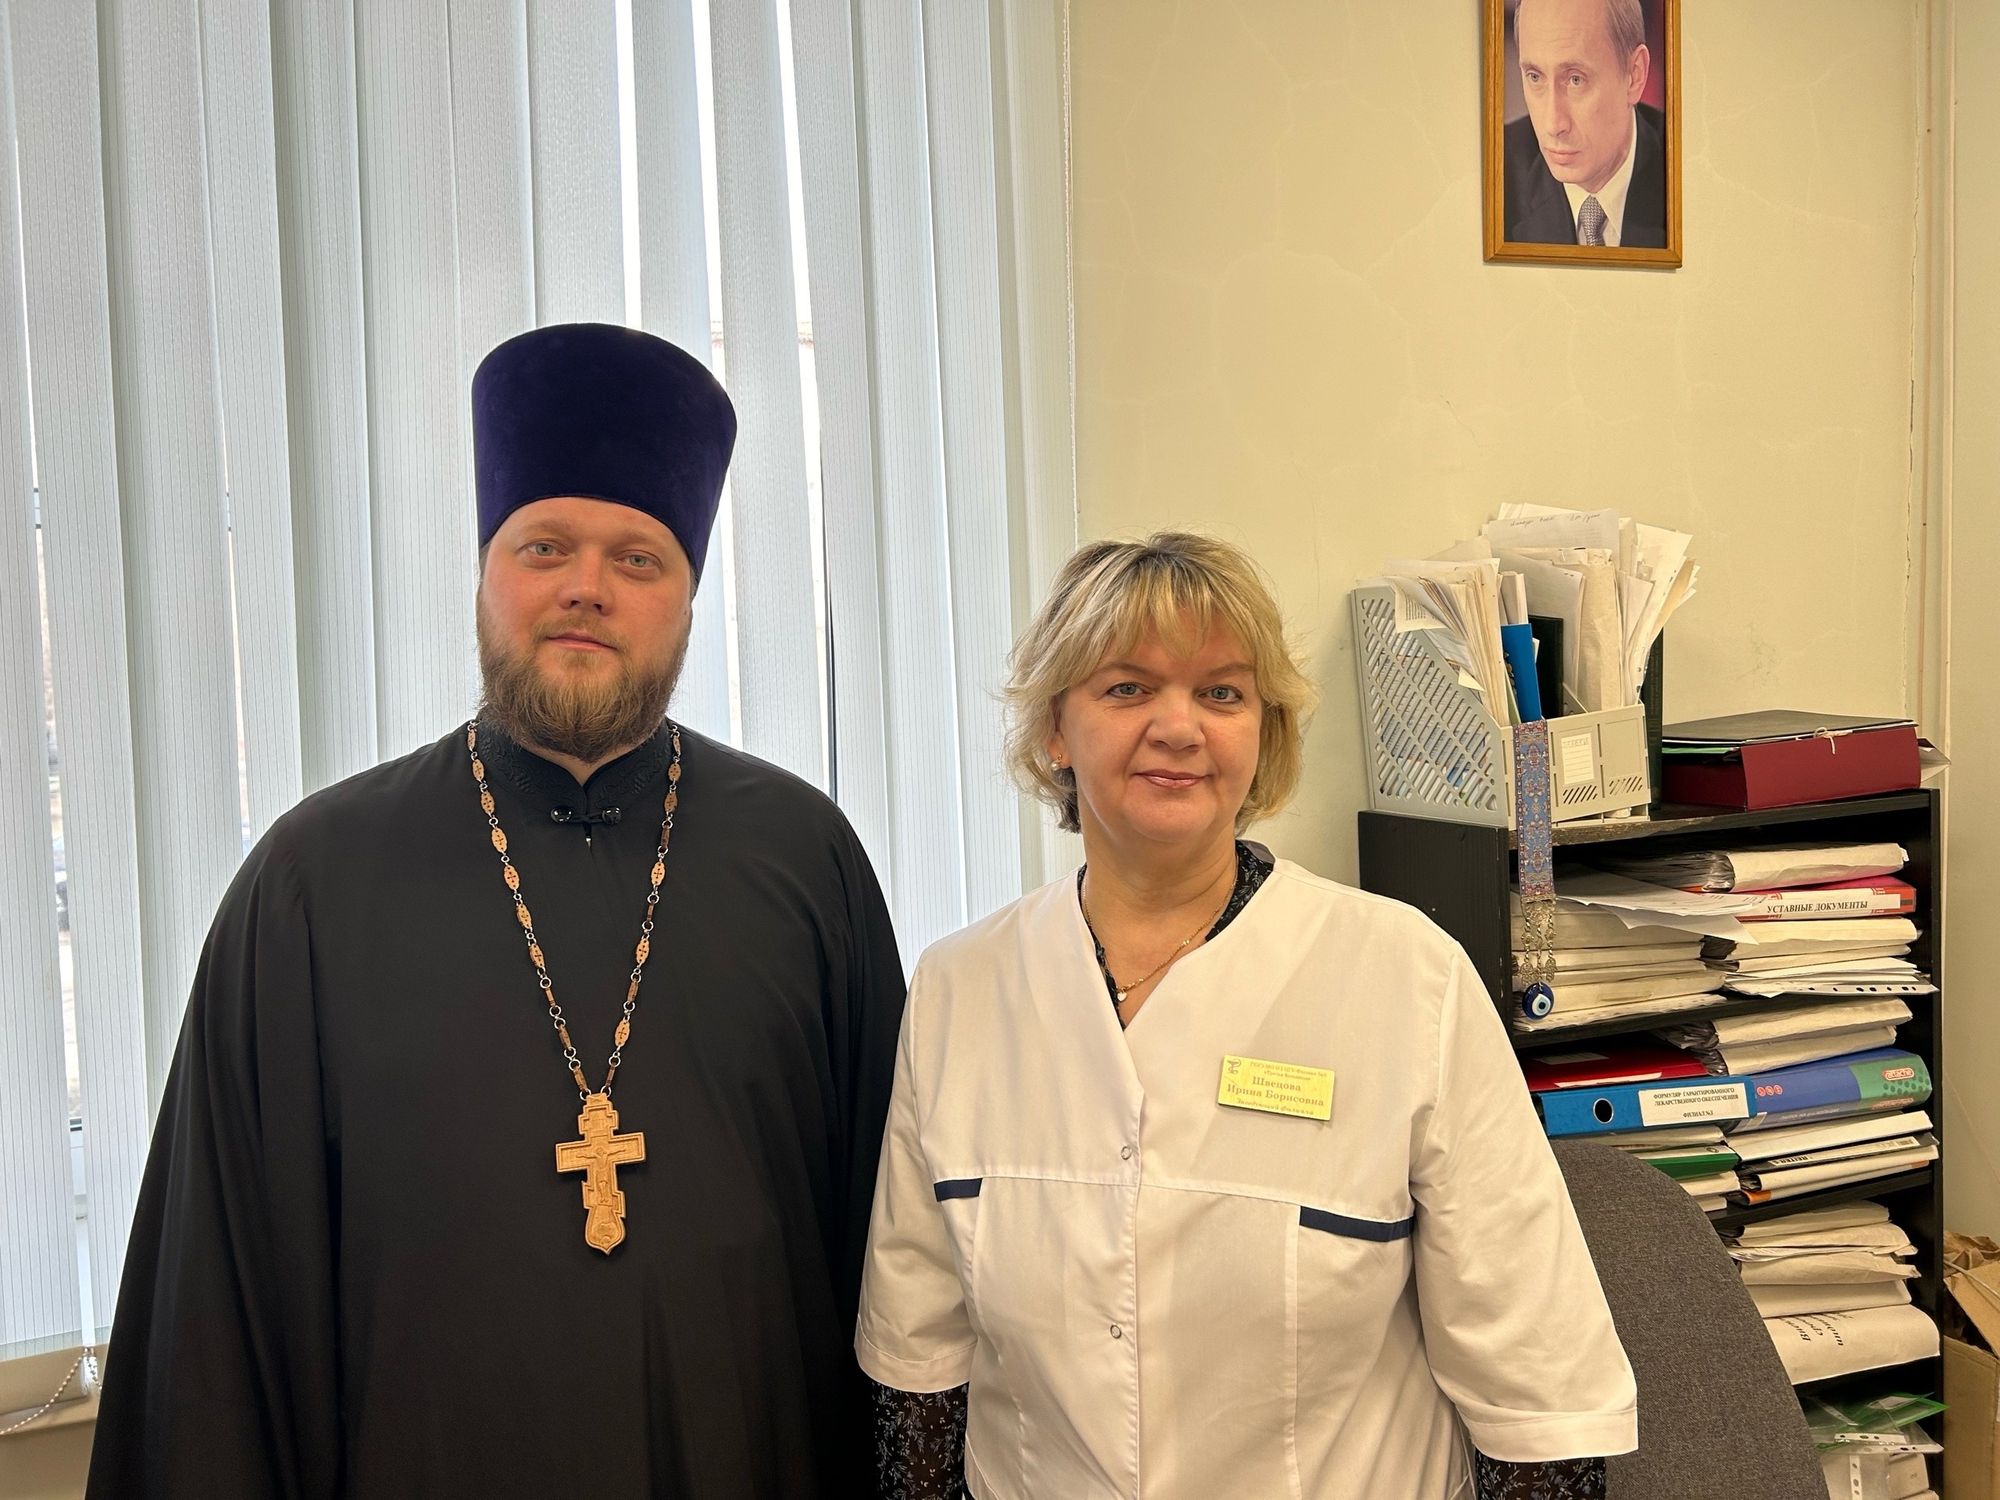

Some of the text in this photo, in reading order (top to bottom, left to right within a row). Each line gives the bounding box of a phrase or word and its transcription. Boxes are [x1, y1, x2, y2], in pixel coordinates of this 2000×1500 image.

[1766, 899, 1868, 914] УСТАВНЫЕ ДОКУМЕНТЫ
[1252, 1076, 1301, 1092] Швецова
[1227, 1084, 1324, 1107] Ирина Борисовна
